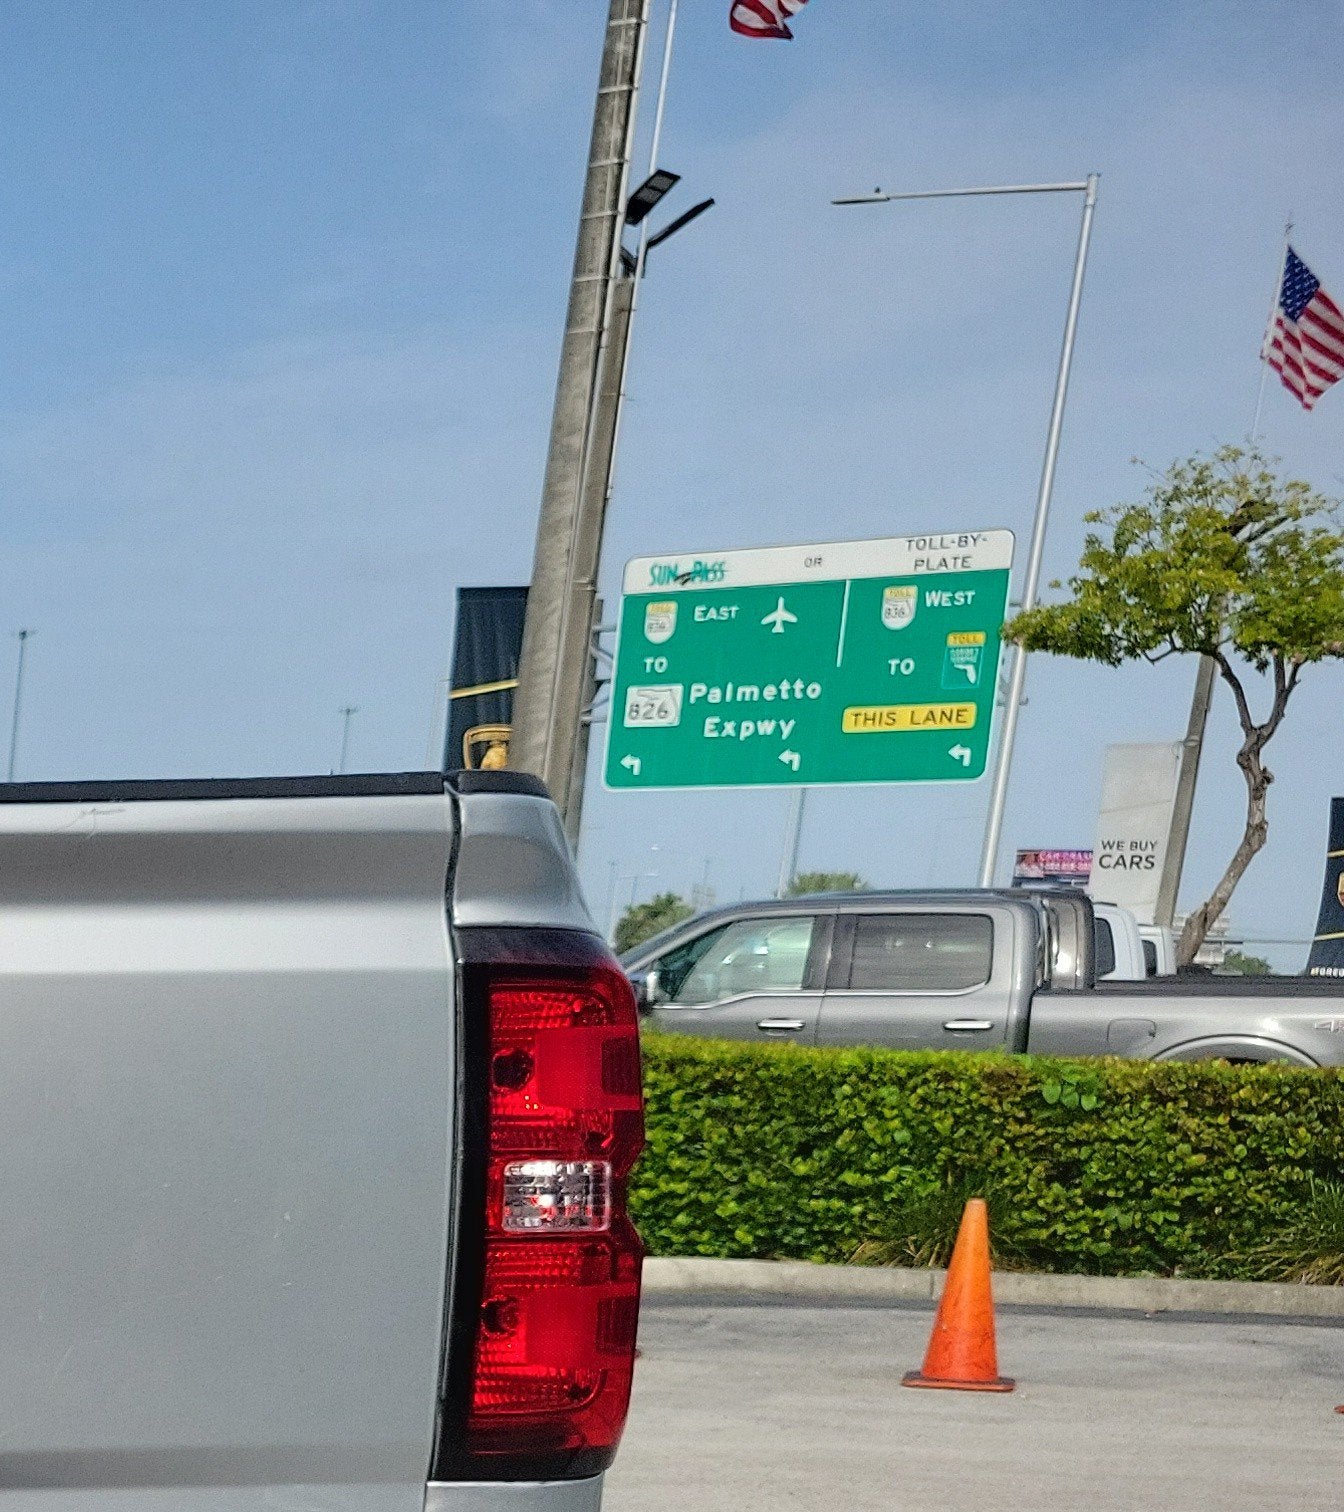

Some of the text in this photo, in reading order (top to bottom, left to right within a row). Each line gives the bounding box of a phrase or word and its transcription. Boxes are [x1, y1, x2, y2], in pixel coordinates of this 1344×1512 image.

[804, 557, 823, 568] OR
[913, 555, 973, 572] PLATE
[925, 590, 976, 607] WEST
[694, 605, 740, 622] EAST
[643, 656, 669, 673] TO
[888, 658, 915, 675] TO
[689, 678, 823, 704] Palmetto
[628, 703, 669, 720] 826
[851, 708, 969, 727] THIS LANE
[703, 716, 796, 741] Expwy
[1101, 840, 1158, 851] WE BUY
[1098, 854, 1156, 870] CARS
